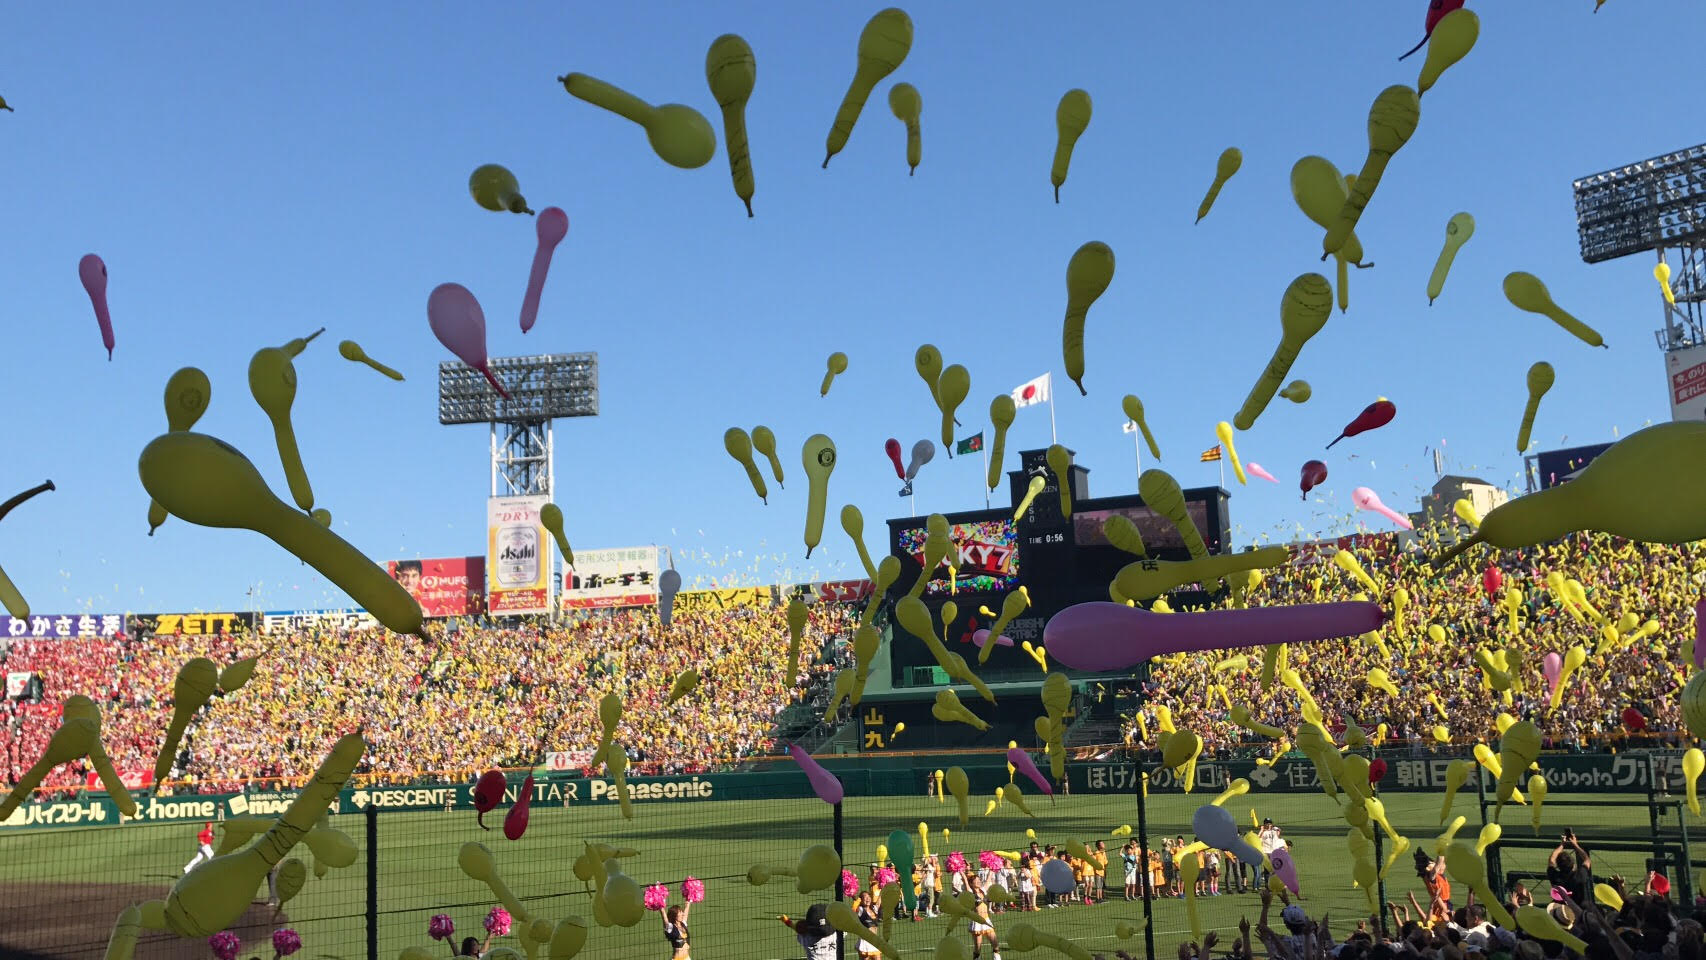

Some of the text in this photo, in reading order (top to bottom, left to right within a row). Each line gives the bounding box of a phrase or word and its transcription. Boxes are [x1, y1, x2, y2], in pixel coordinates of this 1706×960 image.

[1046, 533, 1064, 543] 0:56
[500, 544, 535, 561] Asahi
[8, 615, 120, 636] わかさ生活
[155, 613, 235, 634] ZETT
[864, 707, 885, 748] 山九
[372, 788, 457, 807] DESCENTE
[468, 782, 579, 805] SNTAR
[591, 777, 713, 801] Panasonic
